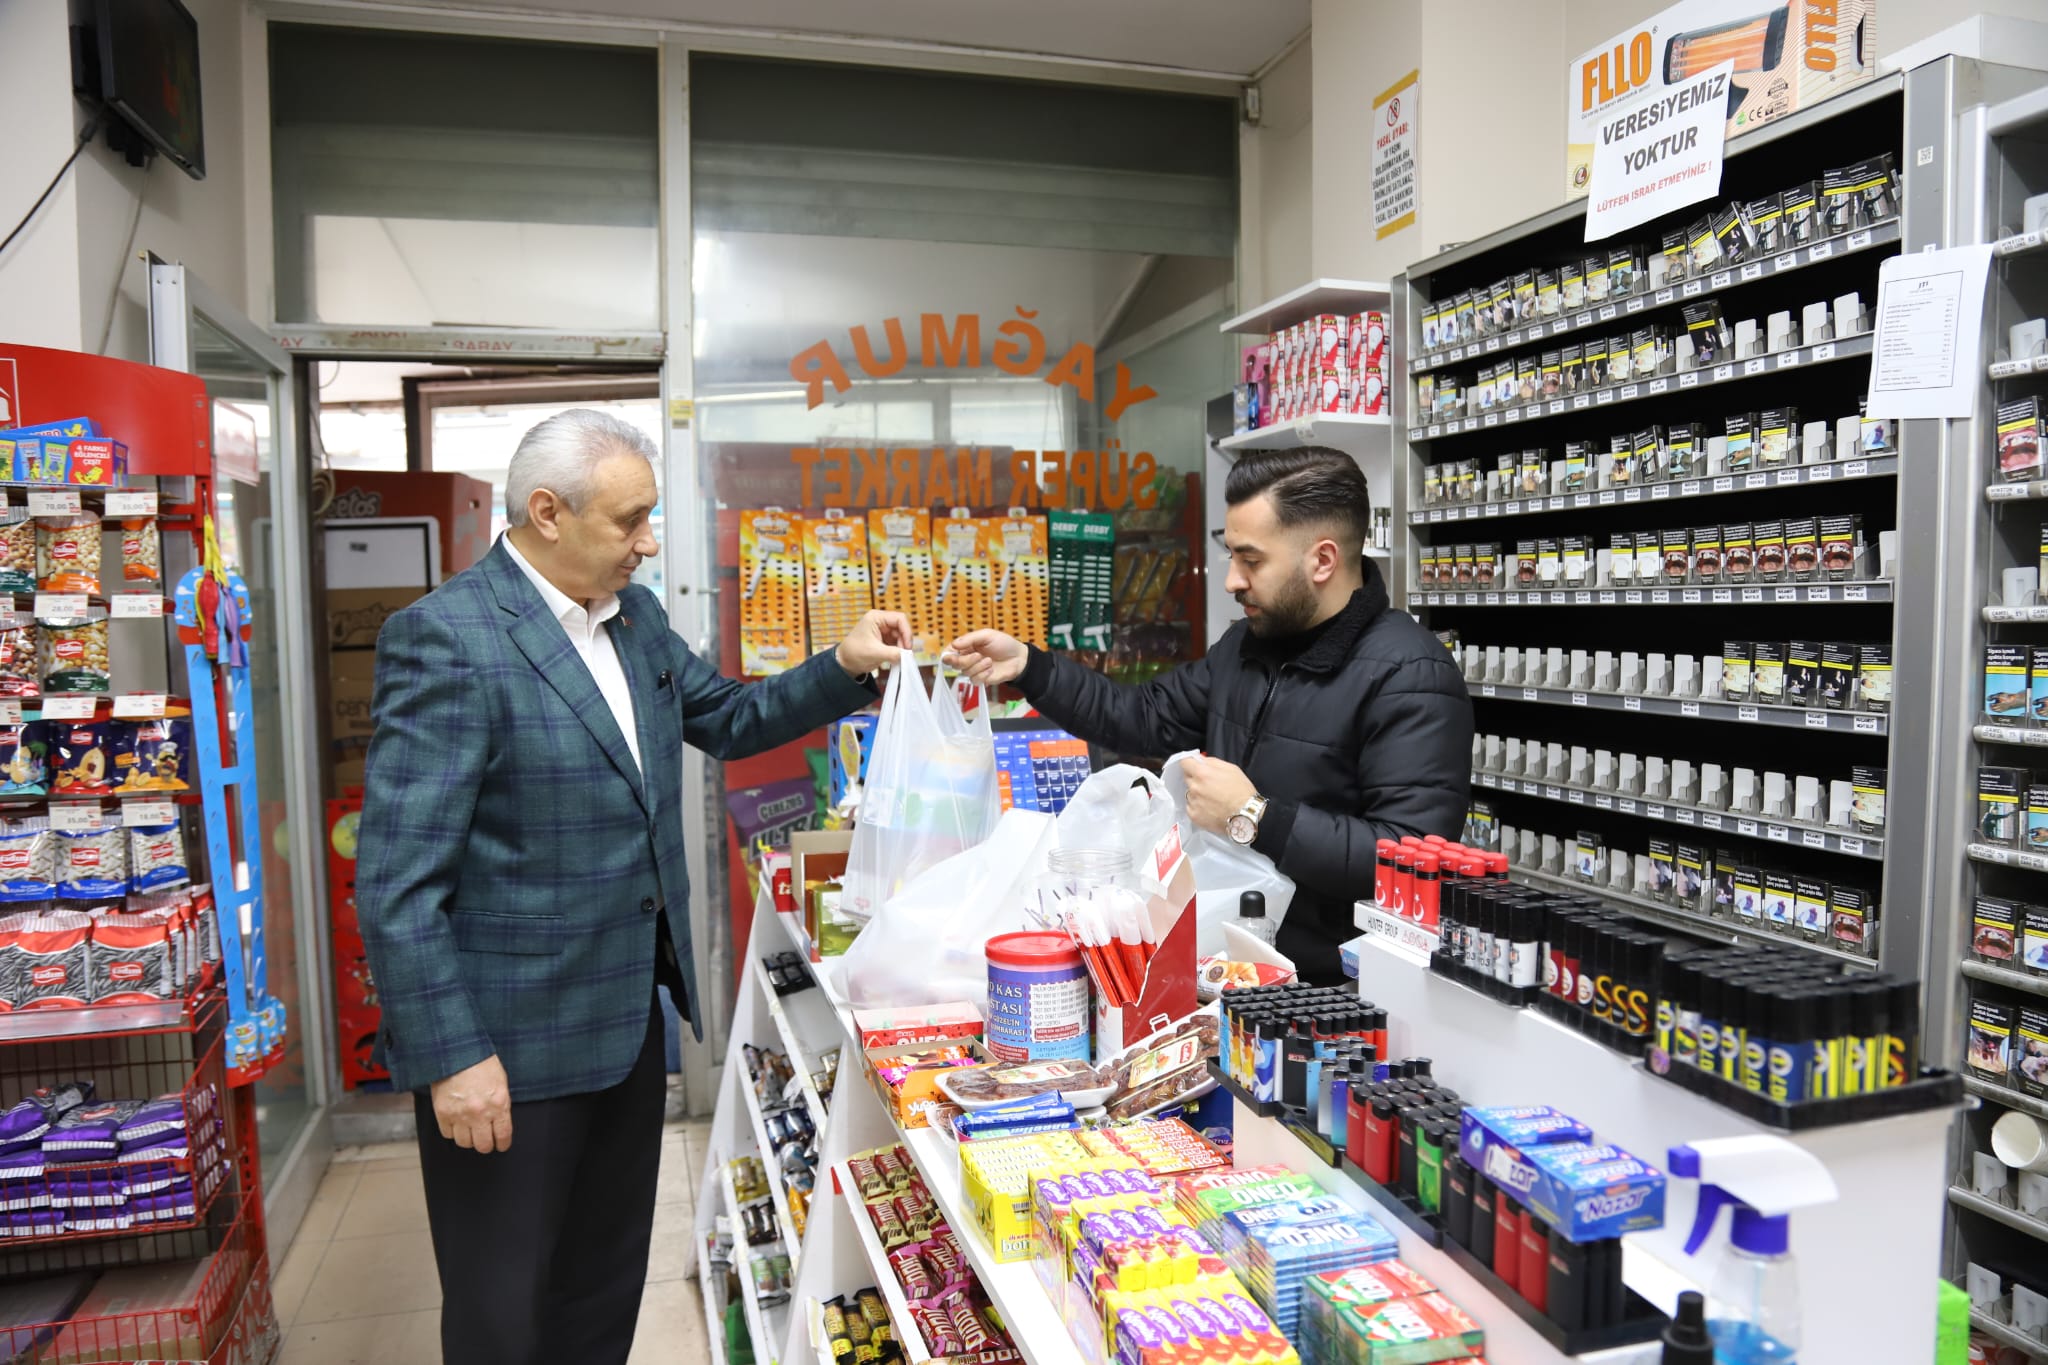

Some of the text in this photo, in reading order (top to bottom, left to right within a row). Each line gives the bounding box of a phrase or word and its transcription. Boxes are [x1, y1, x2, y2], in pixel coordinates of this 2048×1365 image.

[1582, 31, 1653, 112] FLLO
[1623, 126, 1698, 176] YOKTUR
[1597, 191, 1630, 213] LÜTFEN
[1631, 182, 1656, 201] ISRAR
[1051, 521, 1080, 534] DERBY
[1083, 523, 1111, 535] DERBY
[997, 983, 1023, 998] KAS
[1232, 1180, 1297, 1205] ONEO
[1238, 1205, 1289, 1224] ONEO
